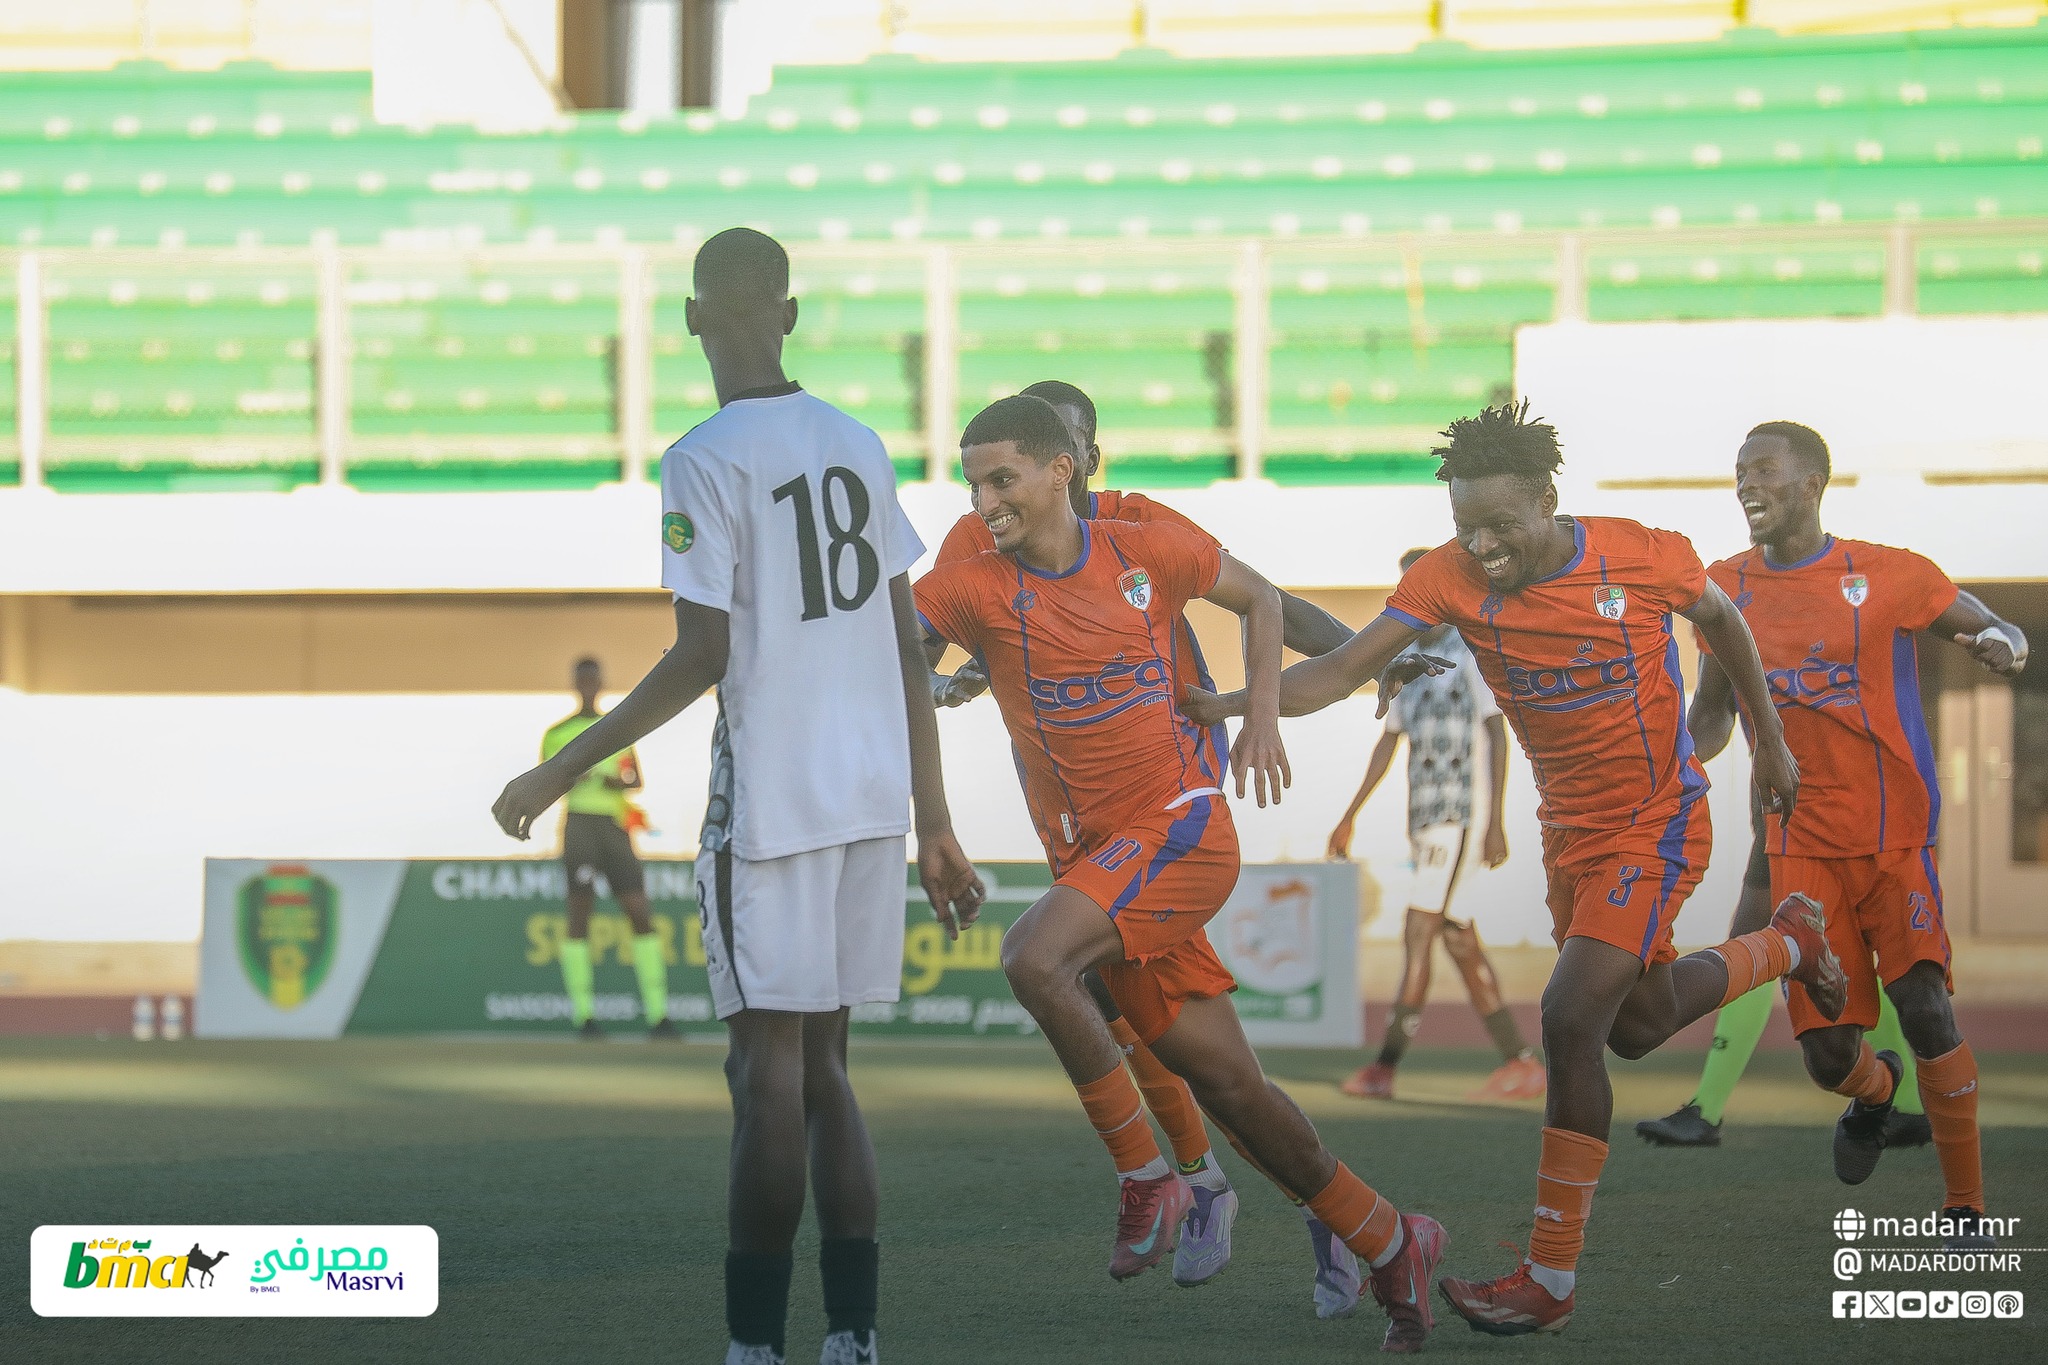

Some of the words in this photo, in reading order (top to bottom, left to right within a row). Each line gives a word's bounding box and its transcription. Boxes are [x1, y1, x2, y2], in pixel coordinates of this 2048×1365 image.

[771, 466, 880, 621] 18
[1087, 836, 1142, 872] 10
[1606, 865, 1642, 908] 3
